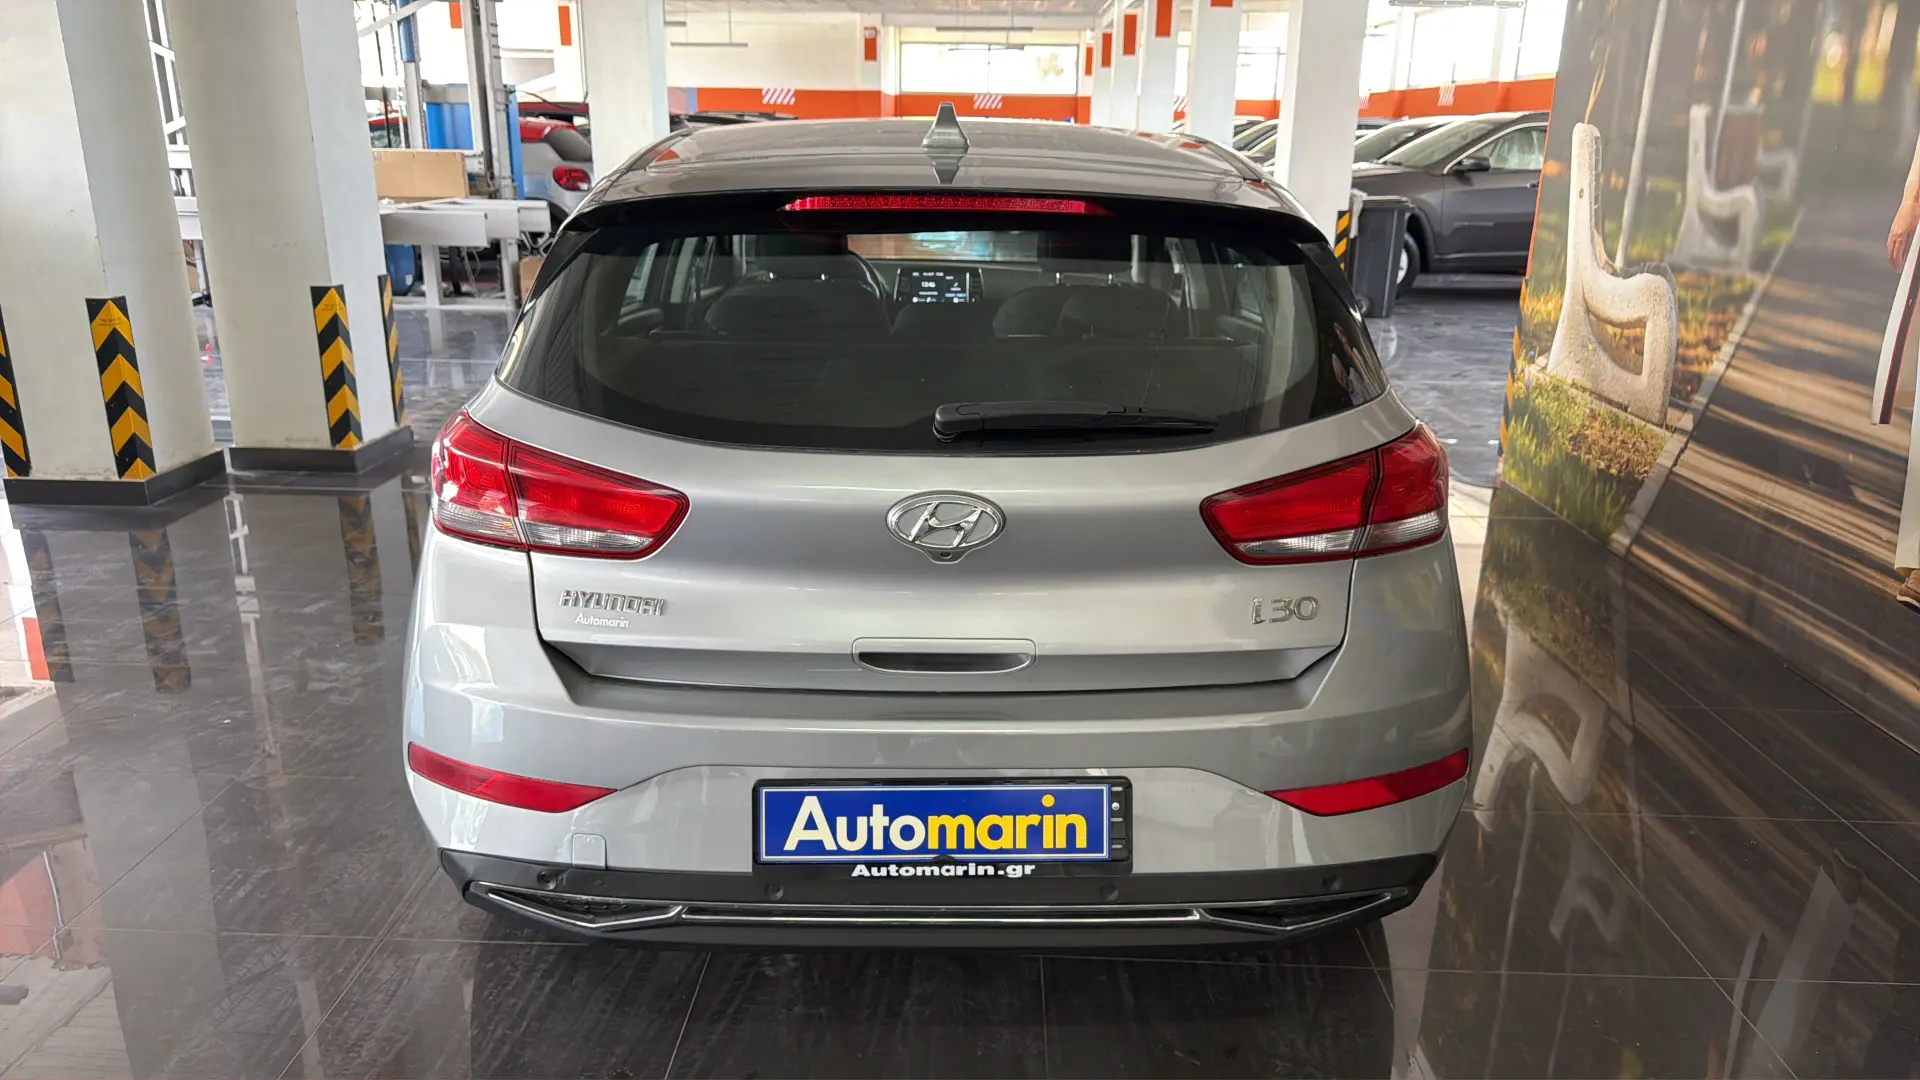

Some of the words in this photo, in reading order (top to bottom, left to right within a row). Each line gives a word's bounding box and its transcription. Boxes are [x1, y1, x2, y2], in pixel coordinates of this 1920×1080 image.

[558, 589, 667, 616] HYUNDAI
[1251, 596, 1320, 625] i30
[574, 612, 629, 628] Automarin
[783, 795, 1088, 852] Automarin
[851, 862, 1036, 879] Automarin.gr
